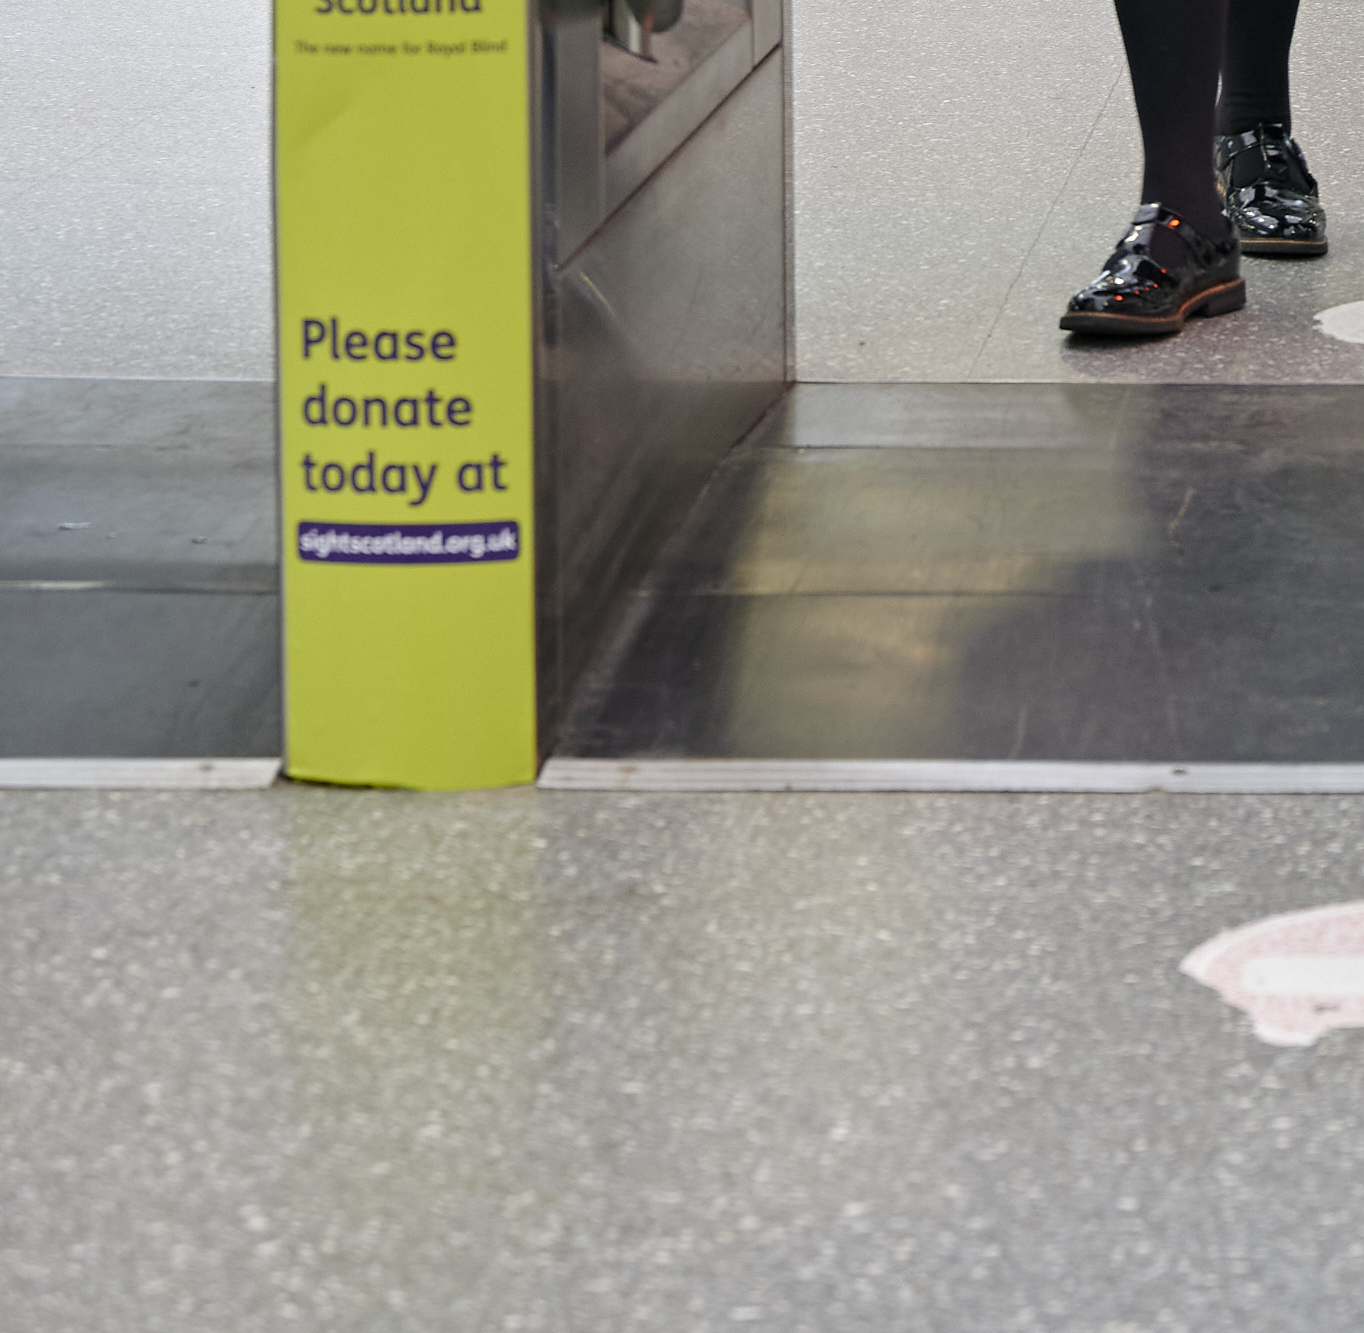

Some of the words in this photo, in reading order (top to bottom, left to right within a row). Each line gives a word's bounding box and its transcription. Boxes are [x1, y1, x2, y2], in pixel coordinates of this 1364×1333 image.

[303, 316, 457, 361] Please
[303, 383, 473, 428] donate
[300, 451, 438, 507] today
[457, 453, 508, 494] at
[300, 527, 517, 559] sightscotland.org.uk
